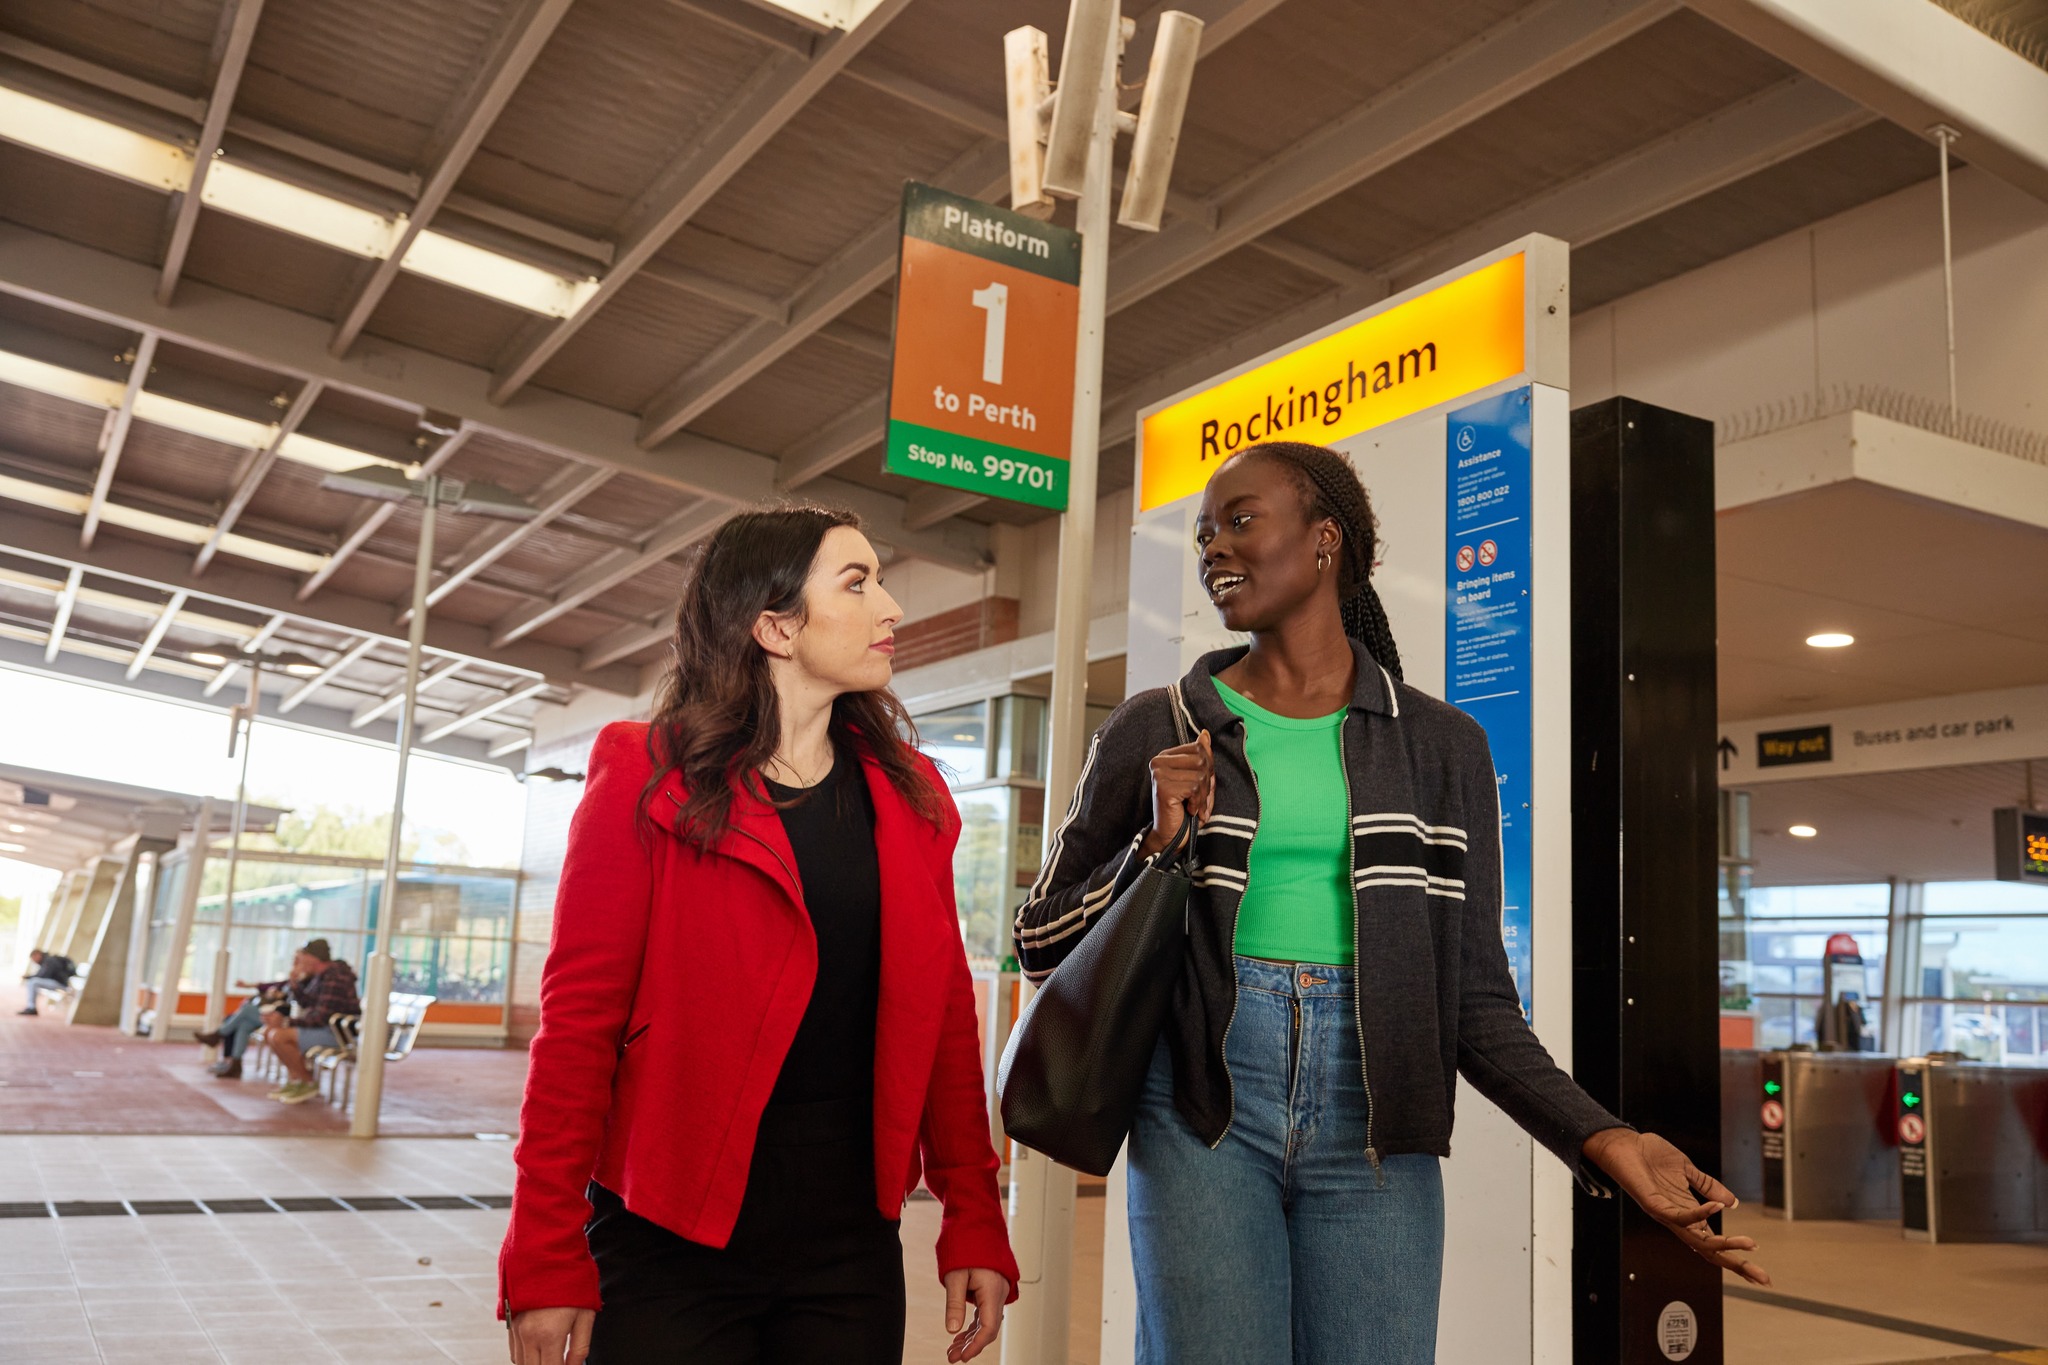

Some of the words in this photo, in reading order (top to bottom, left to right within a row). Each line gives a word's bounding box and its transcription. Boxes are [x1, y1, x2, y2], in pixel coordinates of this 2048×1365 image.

[943, 205, 1050, 259] Platform
[972, 282, 1008, 386] 1
[933, 384, 960, 412] to
[968, 393, 1037, 432] Perth
[1199, 340, 1438, 461] Rockingham
[908, 444, 947, 468] Stop
[951, 453, 978, 474] No.
[982, 454, 1054, 492] 99701
[1458, 449, 1502, 469] Assistance
[1457, 495, 1475, 507] 1800
[1477, 490, 1493, 502] 800
[1494, 485, 1510, 496] 022
[1456, 575, 1490, 591] Bringing
[1492, 570, 1516, 584] items
[1456, 596, 1467, 605] on
[1468, 588, 1491, 603] board
[1762, 737, 1794, 758] Way
[1798, 734, 1826, 754] out
[1853, 729, 1901, 747] Buses
[1905, 723, 1937, 742] and
[1940, 720, 1970, 739] car
[1974, 715, 2015, 738] park
